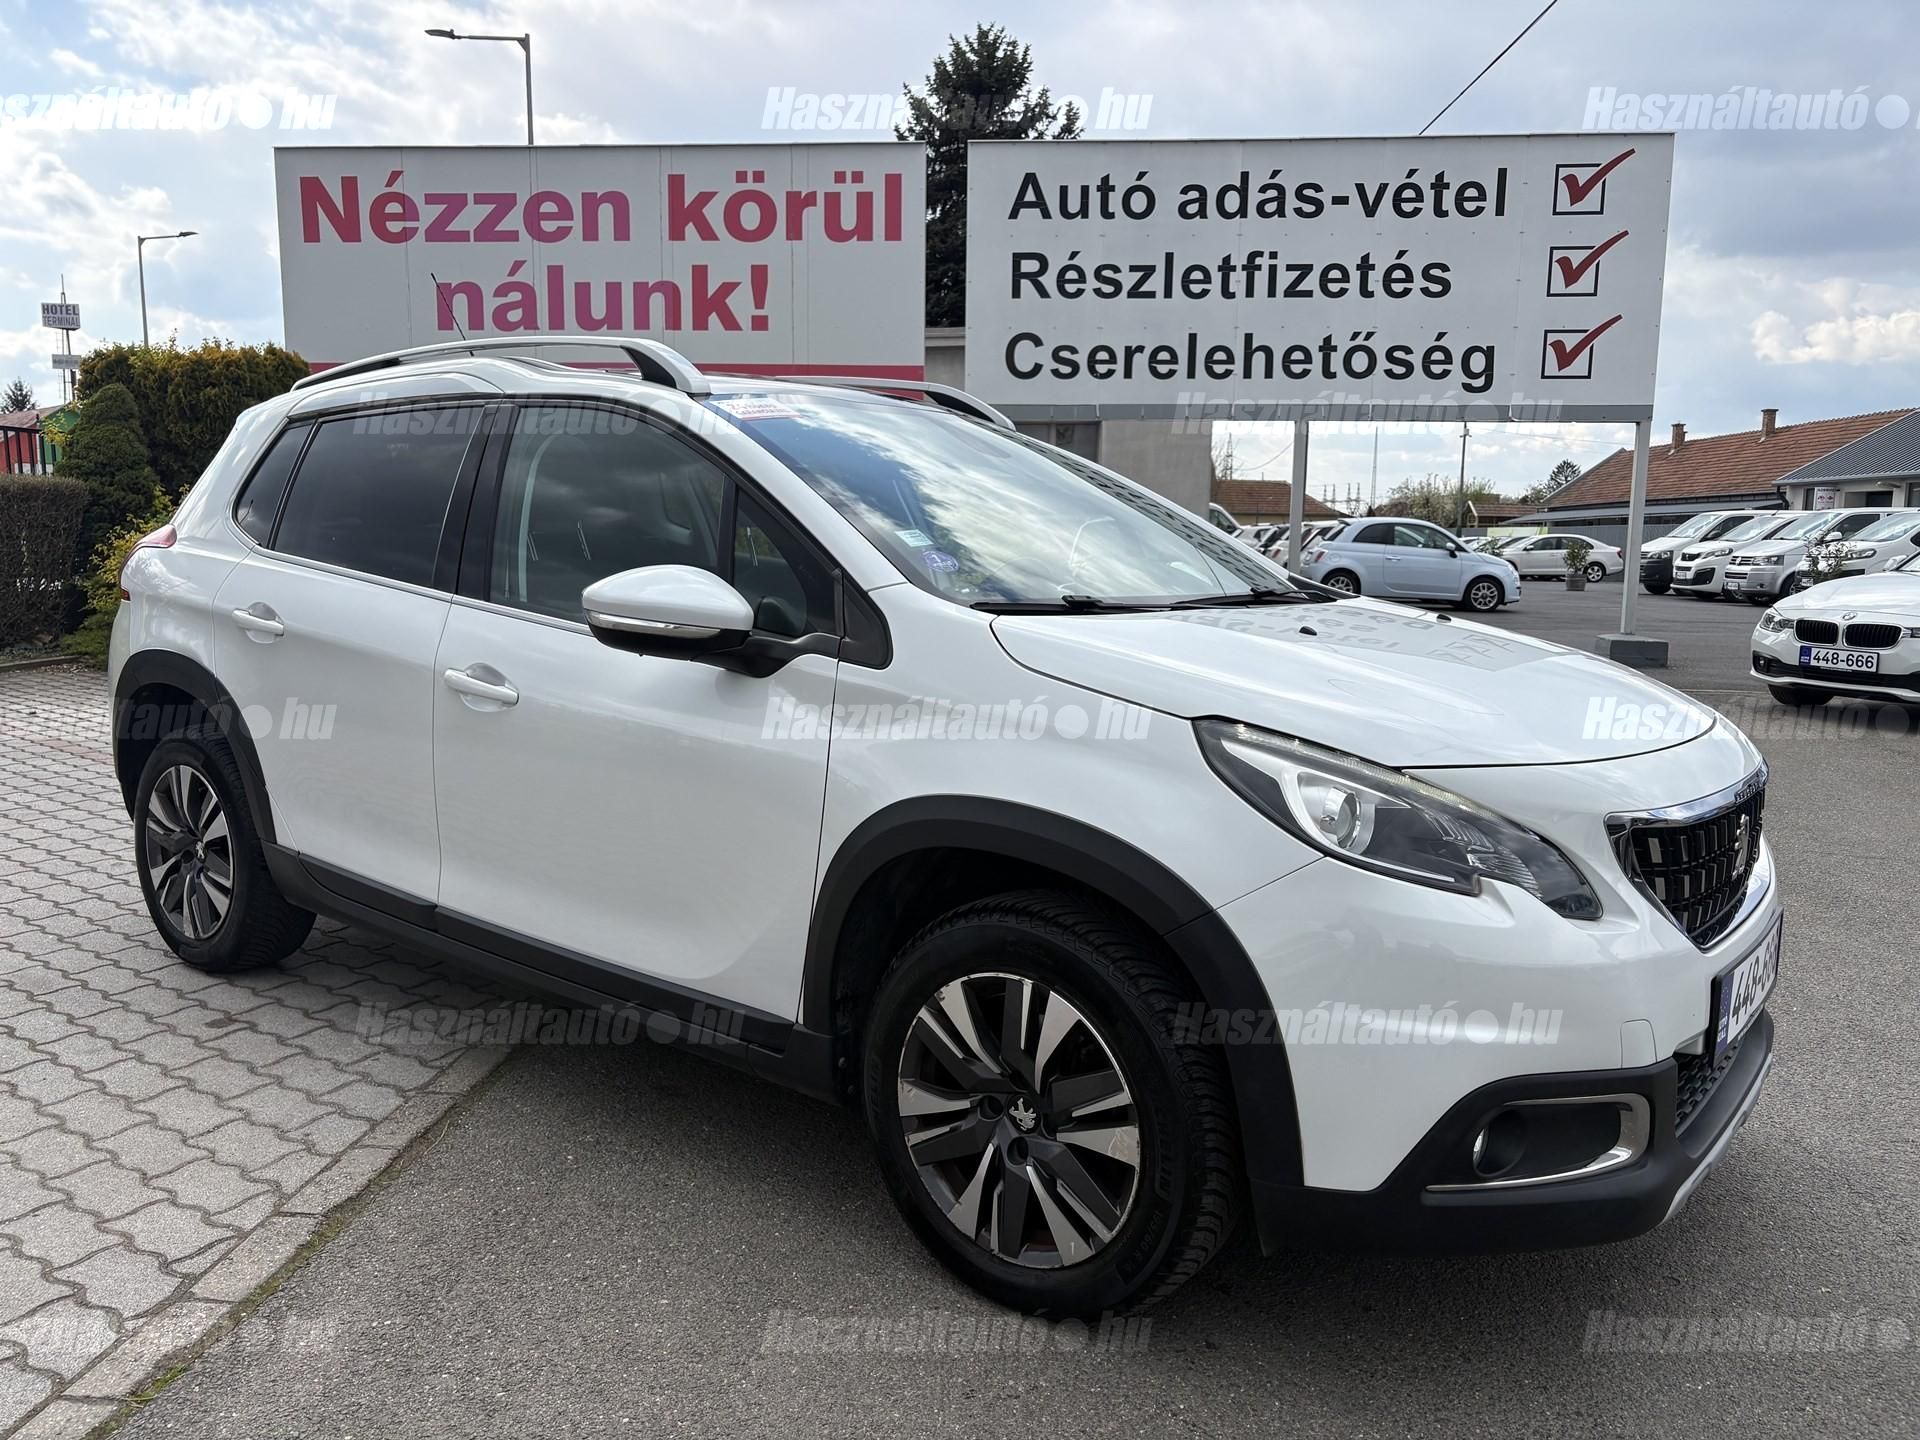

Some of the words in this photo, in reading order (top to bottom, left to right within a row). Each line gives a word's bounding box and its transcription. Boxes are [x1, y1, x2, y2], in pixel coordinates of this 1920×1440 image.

[302, 170, 631, 243] Nézzen
[667, 170, 902, 242] körül
[1008, 170, 1156, 220] Autó
[1177, 167, 1508, 220] adás-vétel
[438, 260, 769, 331] nálunk!
[1011, 249, 1452, 299] Részletfizetés
[42, 304, 79, 315] HOTEL
[43, 315, 80, 327] TERMINAL
[1005, 331, 1496, 394] Cserelehetőség
[1812, 650, 1875, 669] 448-666
